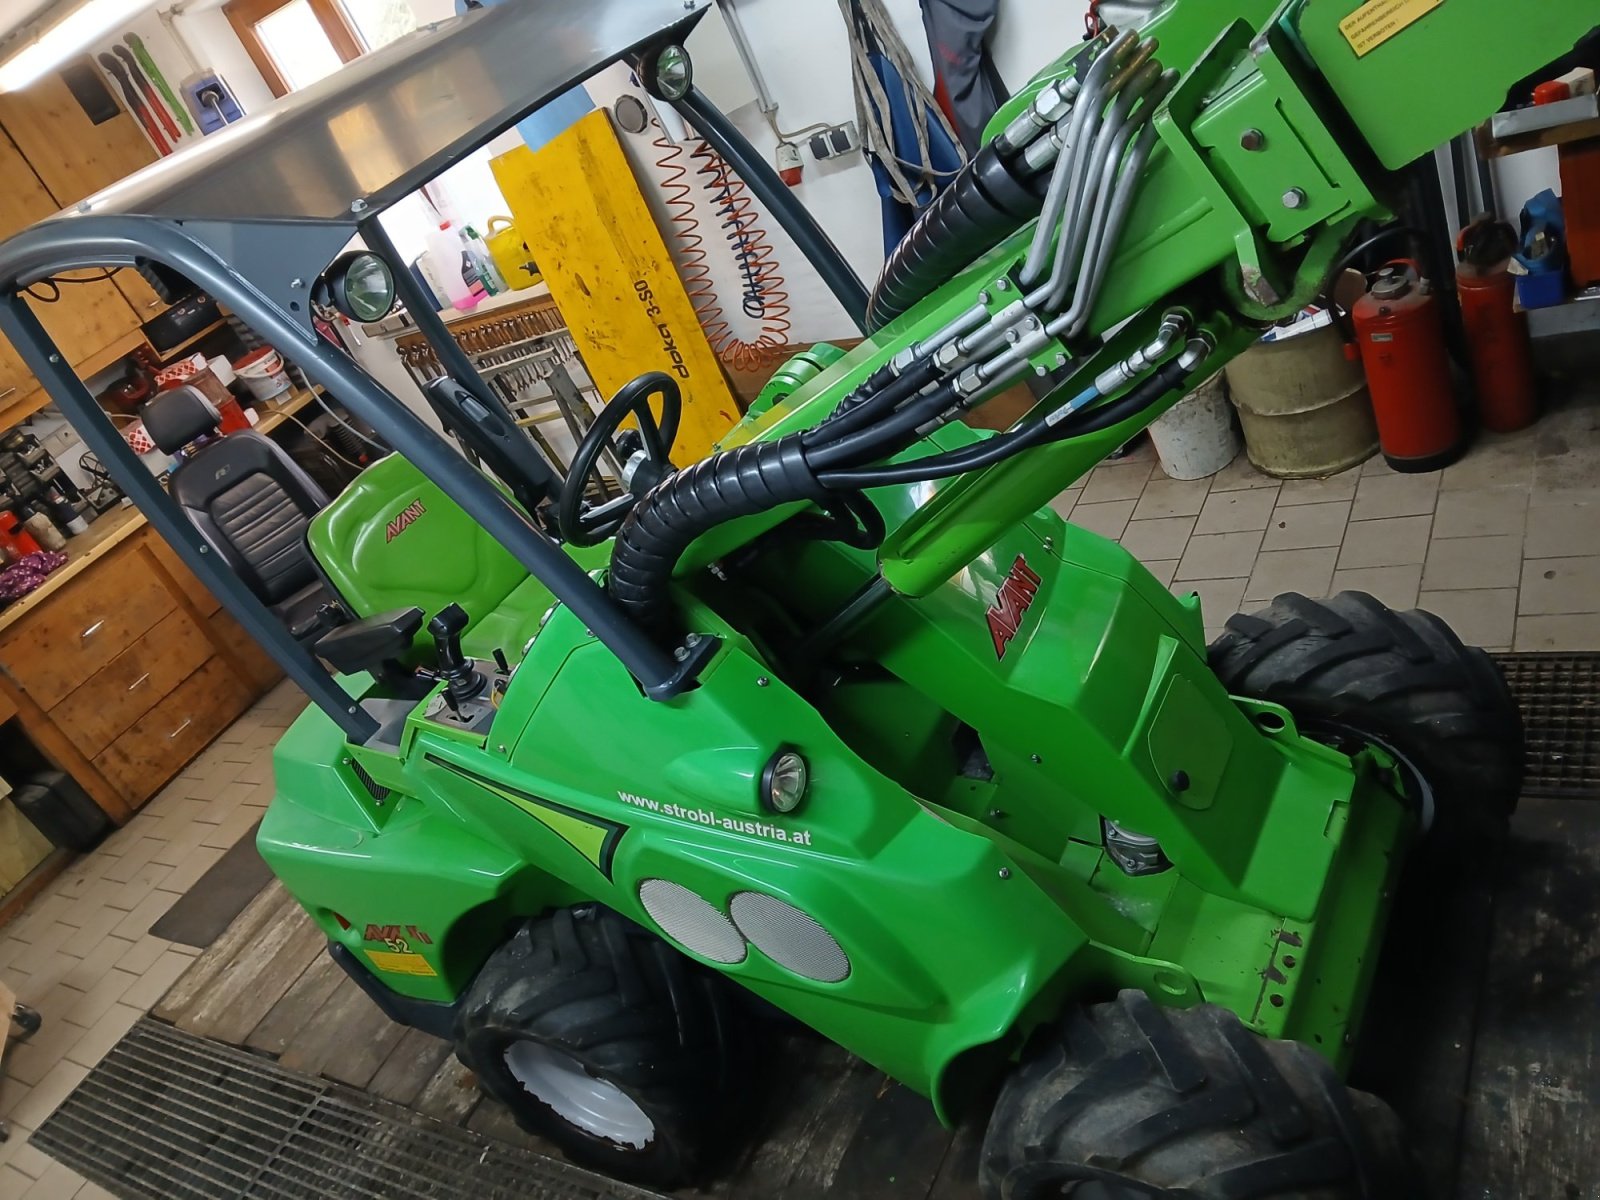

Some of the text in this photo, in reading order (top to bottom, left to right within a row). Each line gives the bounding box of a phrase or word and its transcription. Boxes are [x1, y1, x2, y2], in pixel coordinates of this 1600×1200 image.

[657, 323, 690, 379] doka
[386, 497, 427, 544] AVANT
[985, 553, 1043, 662] AVANT
[617, 790, 812, 847] www.strobl-austria.at
[384, 937, 415, 954] 52
